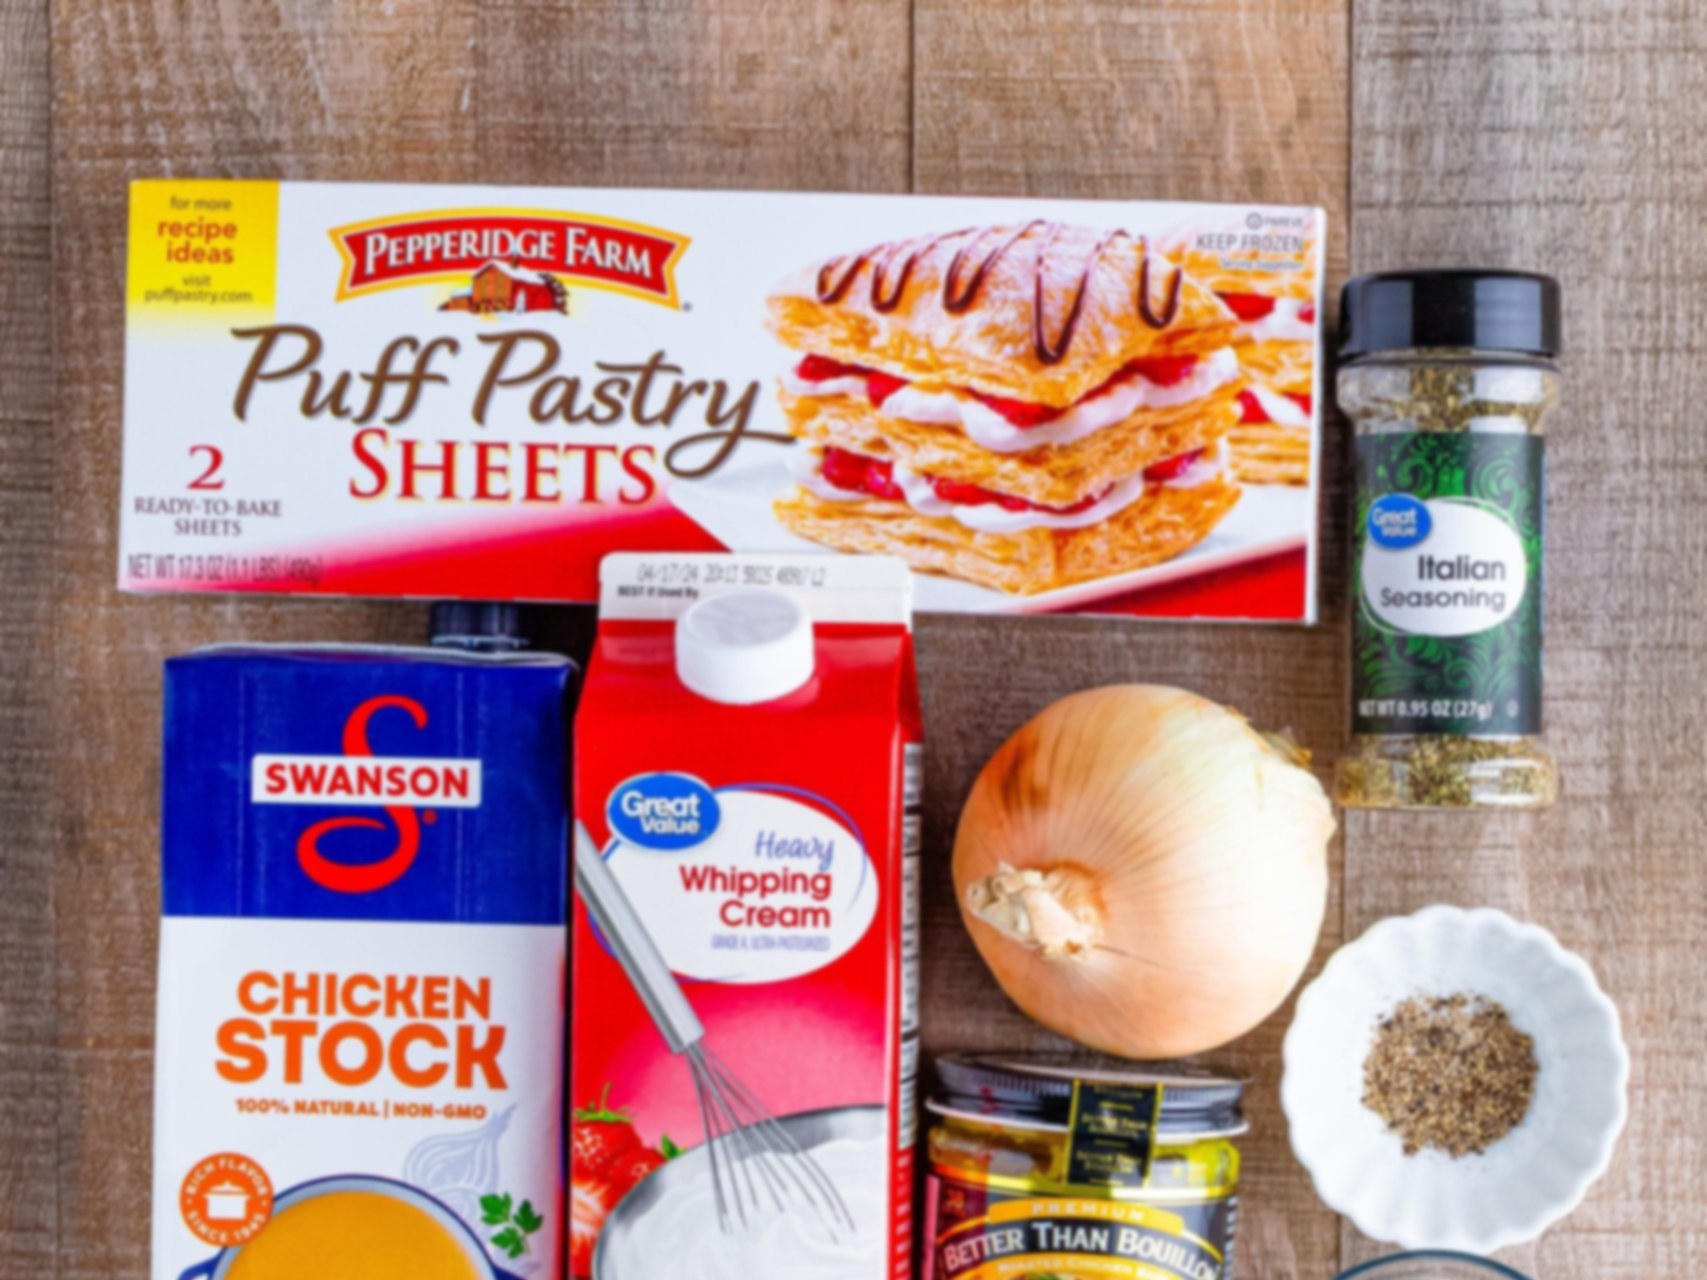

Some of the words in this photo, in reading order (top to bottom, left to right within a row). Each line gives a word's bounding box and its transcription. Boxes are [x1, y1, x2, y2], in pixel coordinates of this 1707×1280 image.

[170, 196, 190, 211] for
[194, 199, 232, 212] more
[157, 217, 238, 244] recipe
[1196, 233, 1237, 251] KEEP
[1241, 234, 1304, 252] FROZEN
[166, 242, 234, 265] ideas
[364, 227, 556, 277] PEPPERIDGE
[564, 226, 652, 280] FARM
[182, 275, 212, 288] visit
[144, 287, 254, 305] puffpastry.com
[230, 324, 462, 428] Puff
[471, 329, 798, 480] Pastry
[185, 443, 226, 491] 2
[348, 427, 658, 506] SHEETS
[133, 497, 283, 517] READY-TO-BAKE
[1371, 507, 1417, 526] Great
[174, 518, 243, 537] SHEETS
[1381, 521, 1417, 538] Value
[128, 555, 151, 580] NET
[155, 555, 174, 580] WT
[1417, 555, 1507, 581] Italian
[618, 585, 645, 598] BEST
[658, 587, 680, 598] Used
[682, 587, 700, 600] By
[1380, 587, 1507, 613] Seasoning
[1377, 700, 1395, 717] WT
[1397, 700, 1428, 718] 0.95
[1430, 701, 1451, 718] OZ
[1453, 701, 1493, 722] (27g)
[264, 762, 469, 799] SWANSON
[620, 789, 701, 819] Great
[640, 814, 700, 835] Value
[753, 829, 836, 872] Heavy
[678, 863, 832, 902] Whipping
[718, 898, 832, 929] Cream
[237, 969, 492, 1021] CHICKEN
[214, 1016, 509, 1092] STOCK
[235, 1097, 290, 1115] 100%
[294, 1098, 380, 1118] NATURAL
[392, 1102, 487, 1122] NON-GMO
[219, 1156, 269, 1197] FLAVOR
[1031, 1202, 1145, 1222] PREMIUM
[187, 1209, 228, 1244] SINCE
[943, 1228, 1025, 1273] BETTER
[1030, 1221, 1111, 1252] THAN
